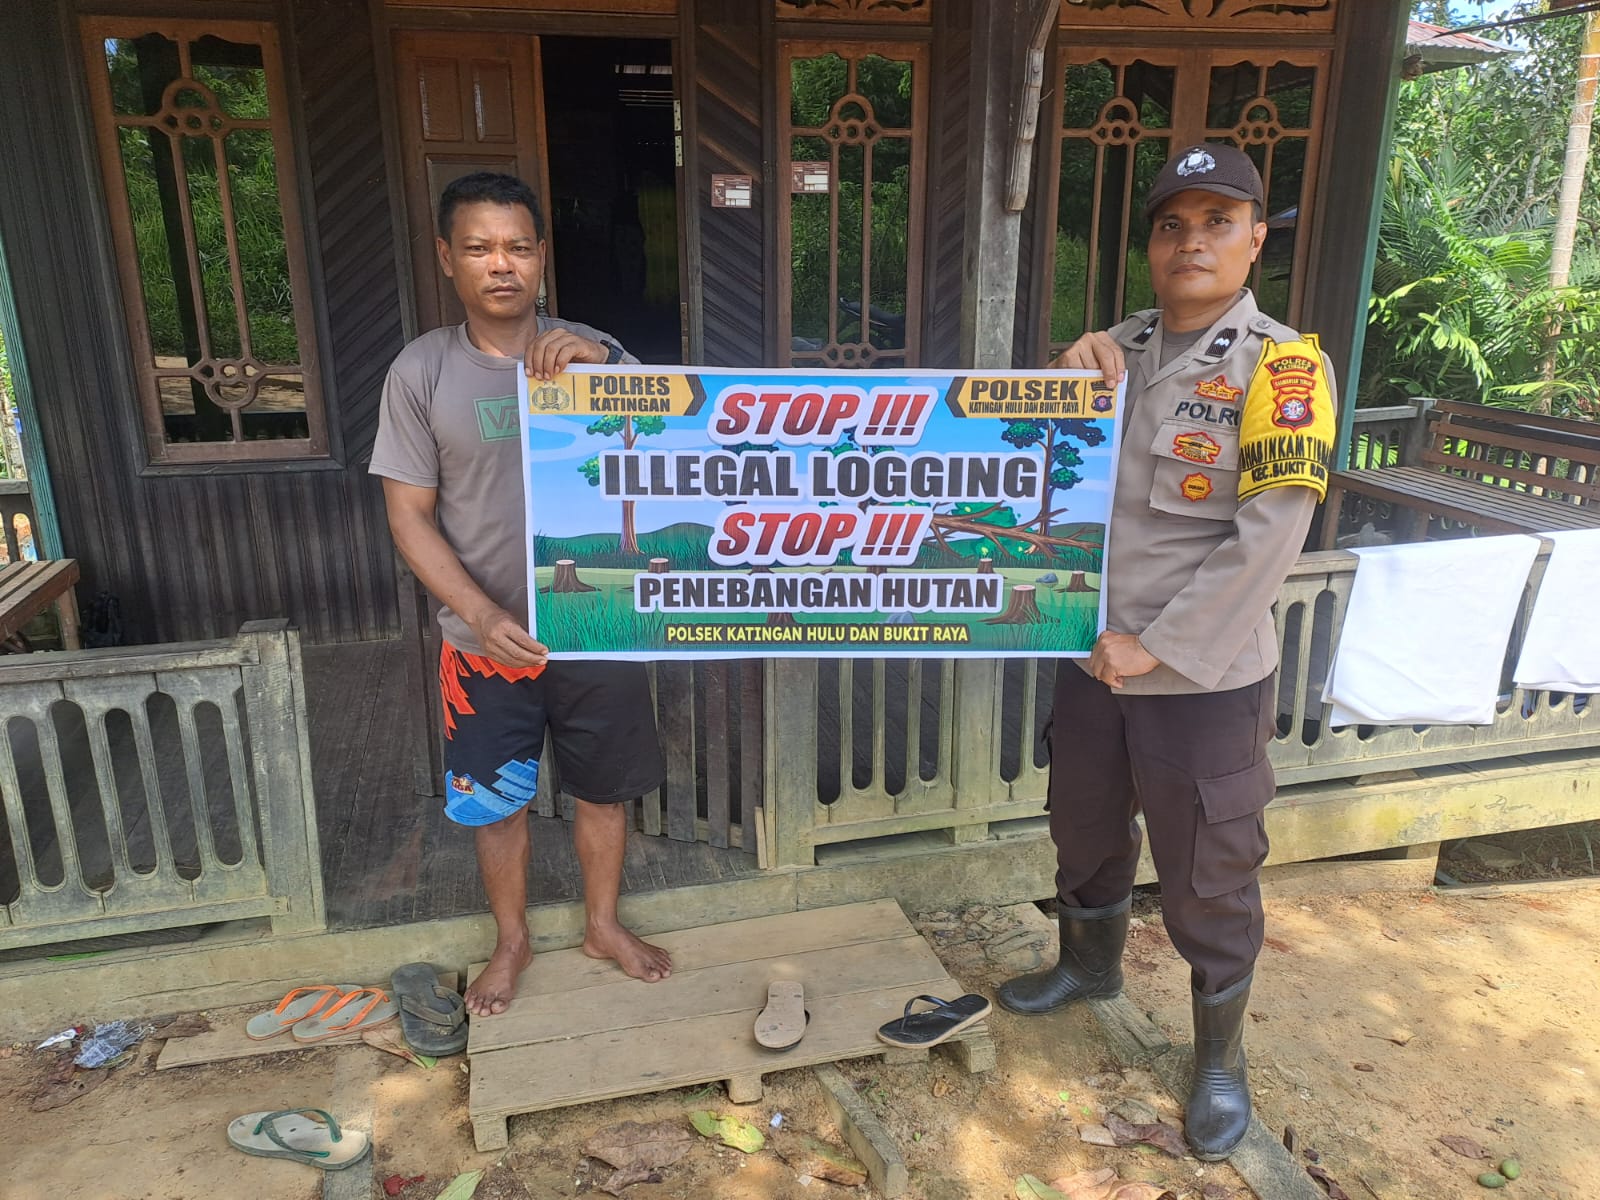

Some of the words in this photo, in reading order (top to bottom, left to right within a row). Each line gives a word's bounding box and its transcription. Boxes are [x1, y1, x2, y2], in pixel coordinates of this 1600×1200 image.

[589, 375, 670, 396] POLRES
[970, 380, 1080, 401] POLSEK
[590, 397, 670, 413] KATINGAN
[715, 392, 860, 436] STOP
[968, 401, 1003, 414] KATINGAN
[1004, 401, 1023, 414] HULU
[1024, 401, 1038, 414] DAN
[1039, 402, 1061, 414] BUKIT
[1062, 402, 1079, 414] RAYA
[1175, 401, 1239, 426] POLRI
[604, 455, 799, 497] ILLEGAL
[813, 456, 1037, 498] LOGGING
[716, 511, 857, 556] STOP
[639, 577, 872, 608] PENEBANGAN
[882, 578, 999, 608] HUTAN
[667, 626, 722, 642] POLSEK
[727, 626, 803, 642] KATINGAN
[806, 626, 846, 642] HULU
[850, 626, 880, 642] DAN
[883, 626, 930, 642] BUKIT
[933, 626, 968, 642] RAYA
